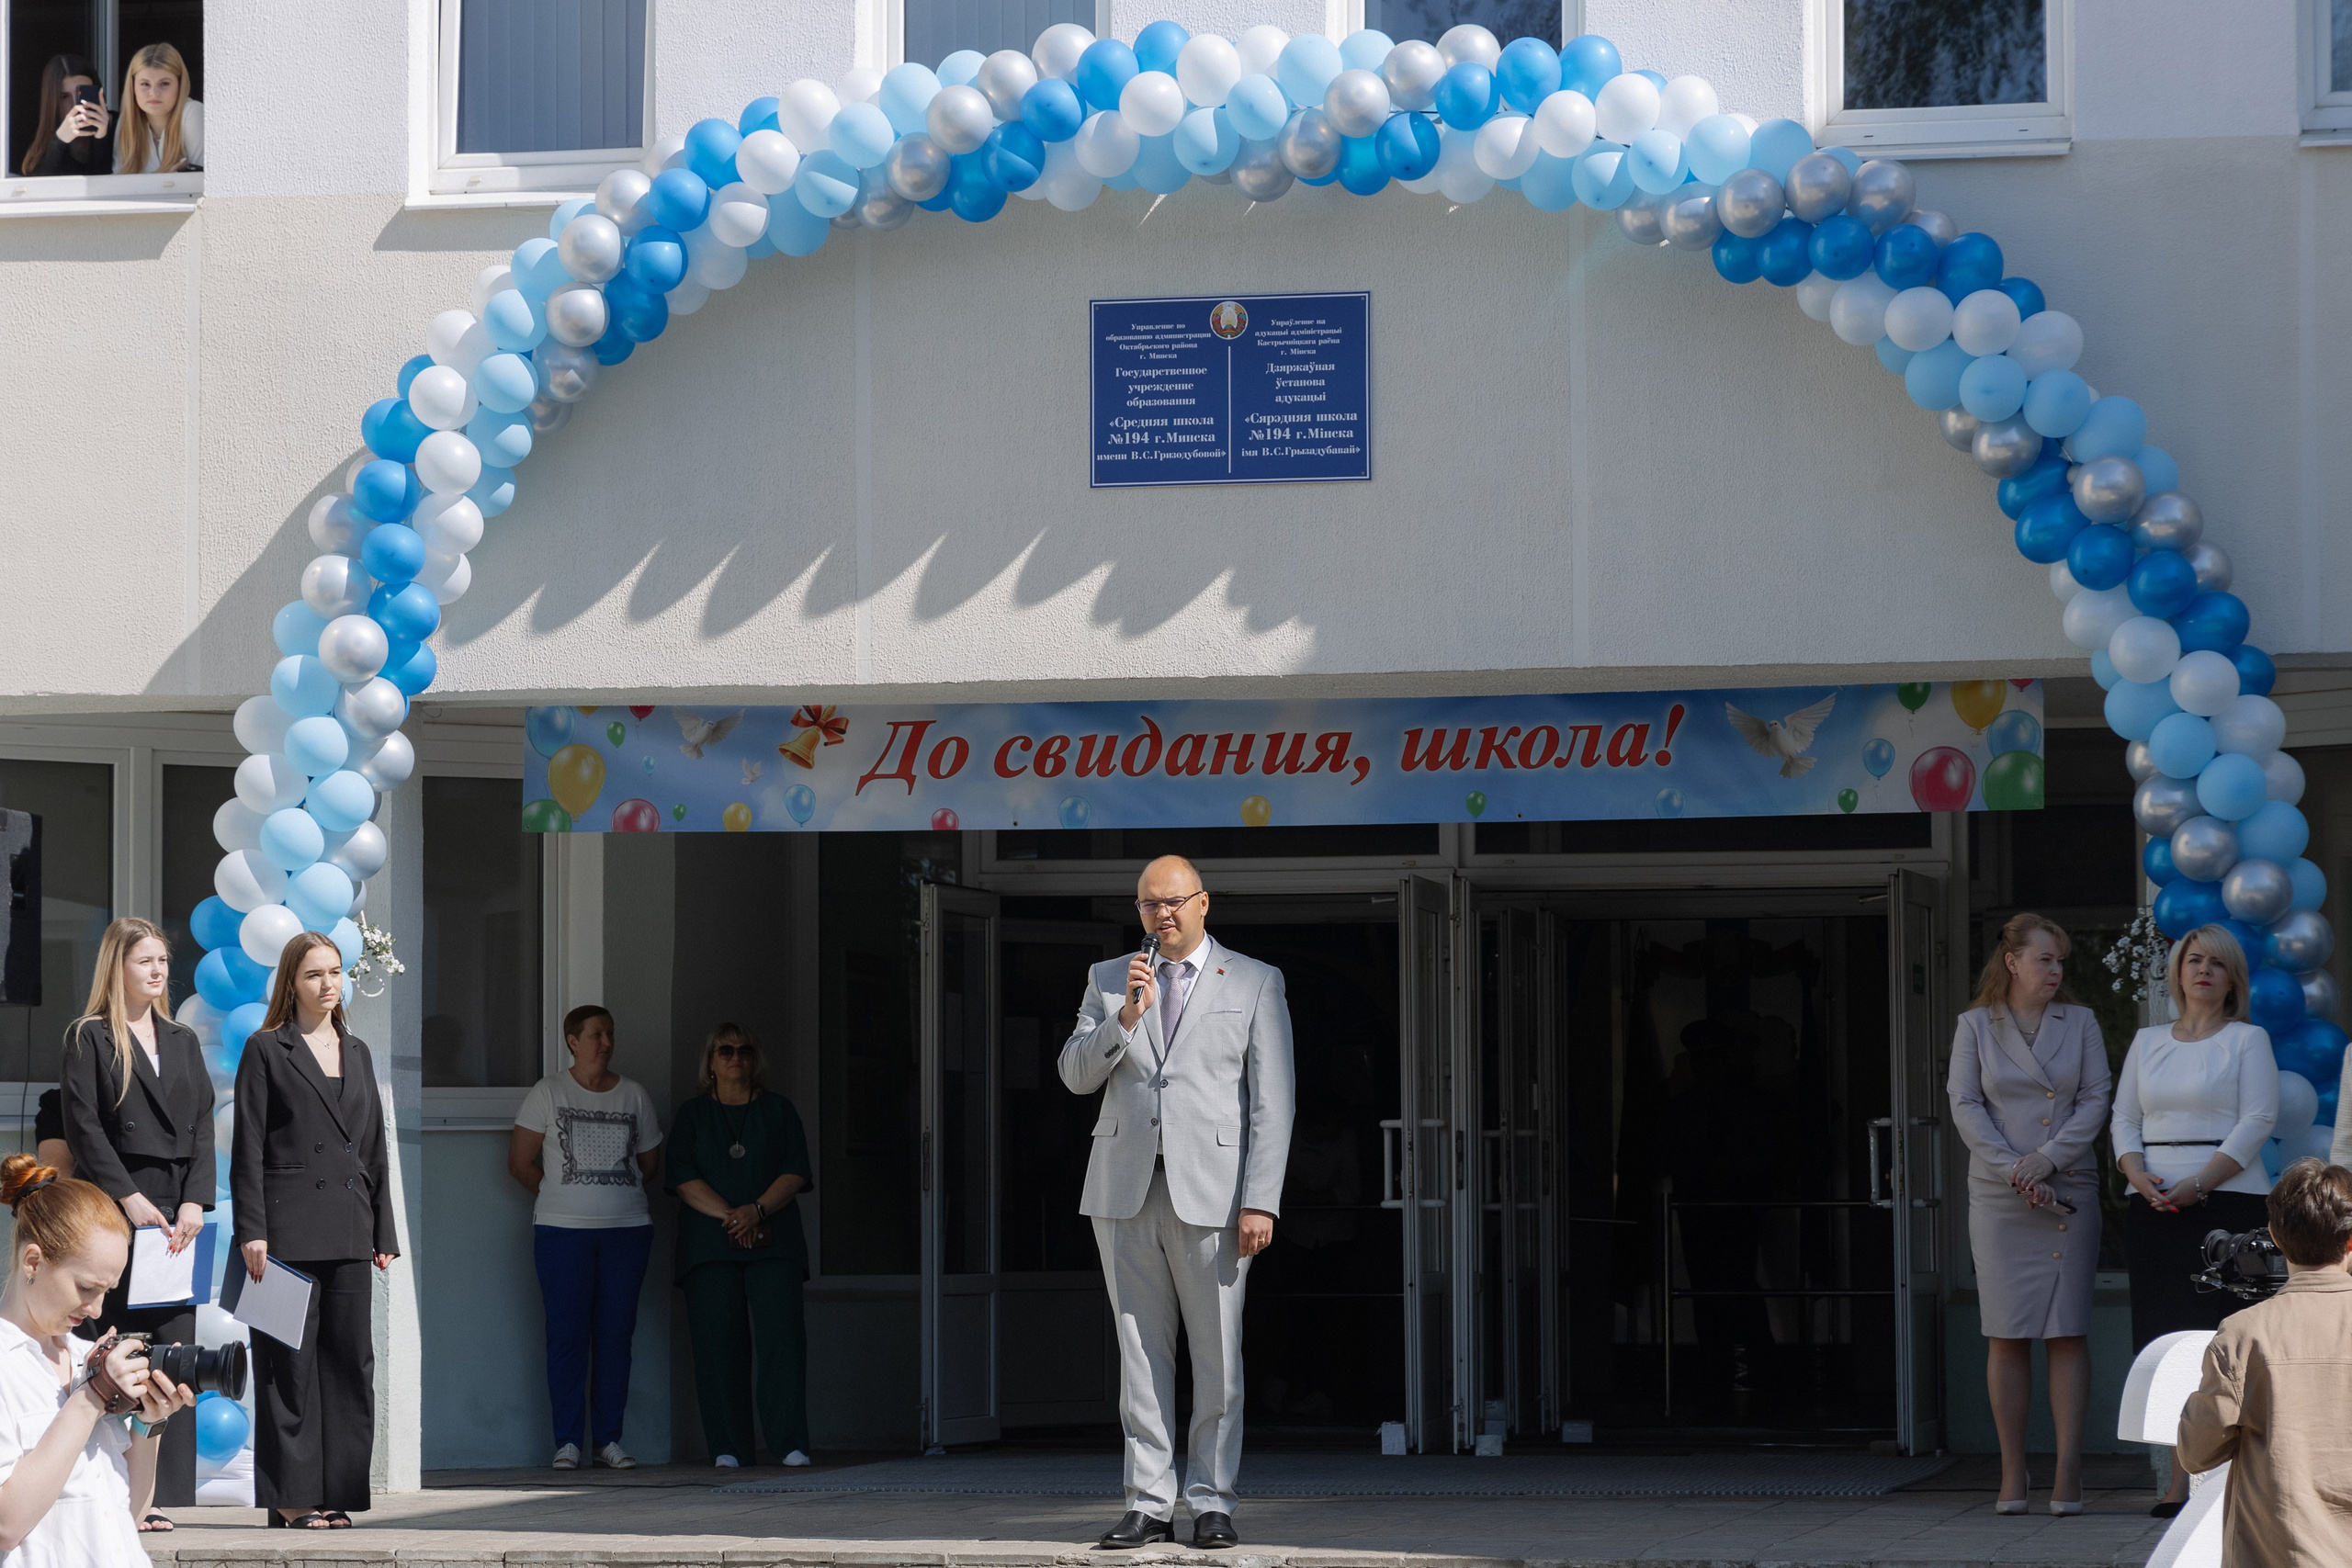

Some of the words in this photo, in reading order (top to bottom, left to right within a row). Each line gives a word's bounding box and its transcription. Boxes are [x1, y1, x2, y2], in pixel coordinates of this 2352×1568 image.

[1131, 323, 1175, 332] Управление
[1254, 329, 1289, 337] адукацыі
[1290, 327, 1342, 335] адміністрацыі
[1105, 333, 1153, 343] образованию
[1257, 338, 1317, 347] Кастрычніцкага
[1318, 338, 1340, 346] раёна
[1119, 343, 1170, 351] Октябрьского
[1171, 342, 1198, 350] района
[1115, 367, 1207, 378] Государственное
[1265, 361, 1335, 374] Дзяржаўная
[1127, 382, 1194, 394] учреждение
[1275, 378, 1326, 389] ўстанова
[1126, 397, 1196, 409] образования
[1275, 392, 1326, 404] адукацыі
[1109, 416, 1169, 430] «Средняя
[1172, 416, 1215, 425] школа
[1244, 412, 1312, 425] «Сярэдняя
[1316, 412, 1358, 422] школа
[1107, 432, 1149, 445] №194
[1154, 432, 1216, 444] г.Минска
[1249, 427, 1292, 441] №194
[1295, 428, 1354, 439] г.Мінска
[1097, 453, 1127, 461] имени
[1131, 449, 1227, 461] В.С.Гризодубовой»
[1241, 448, 1258, 457] імя
[1261, 445, 1361, 457] В.С.Грызадубавай»
[855, 719, 969, 796] До
[993, 715, 1372, 786] свидания,
[1400, 704, 1685, 773] школа!
